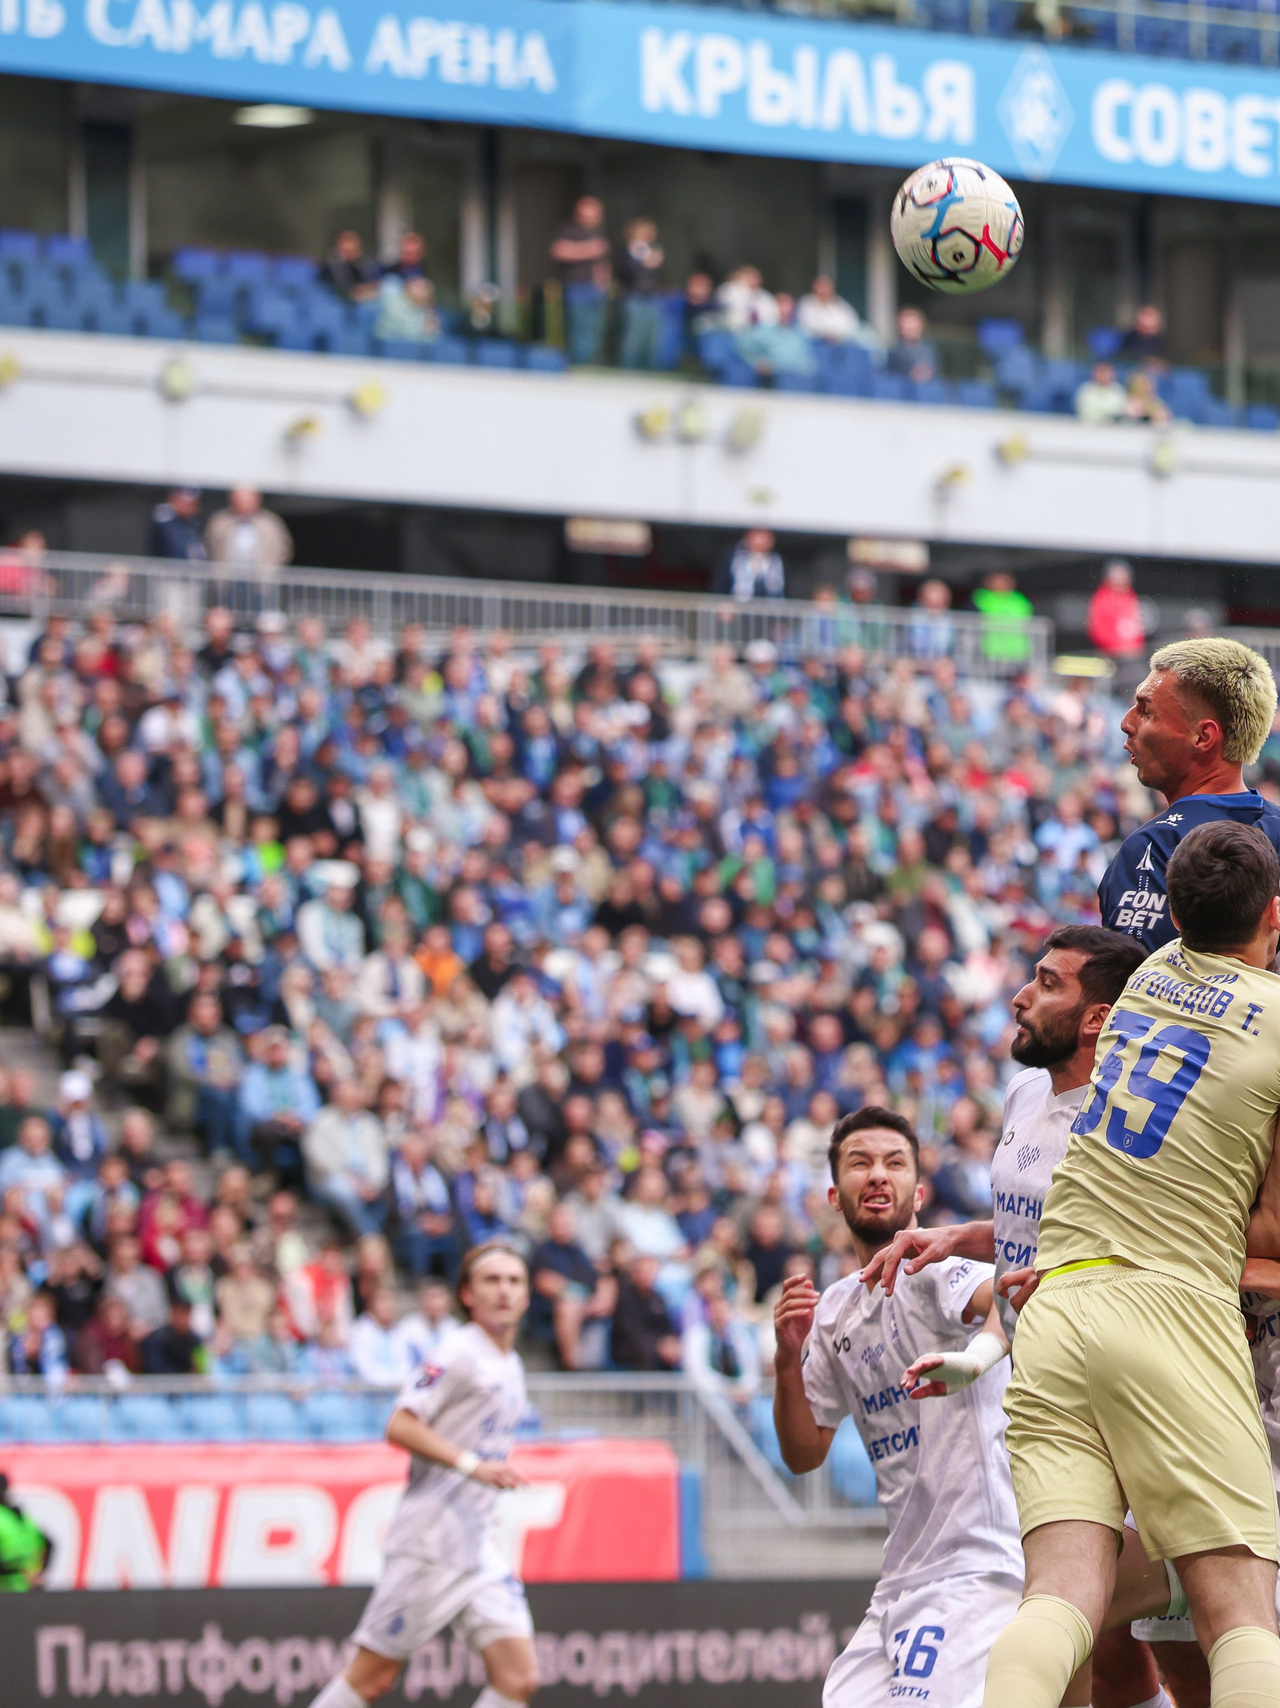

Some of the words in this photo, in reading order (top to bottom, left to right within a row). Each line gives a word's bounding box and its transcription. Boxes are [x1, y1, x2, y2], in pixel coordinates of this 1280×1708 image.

[84, 0, 352, 72] САМАРА
[364, 14, 557, 95] АРЕНА
[639, 26, 976, 147] КРЫЛЬЯ
[1115, 909, 1165, 930] BET
[1118, 890, 1168, 911] FON
[1241, 1002, 1264, 1037] Т.
[1070, 1009, 1211, 1159] 39
[35, 1622, 362, 1707] Платформ
